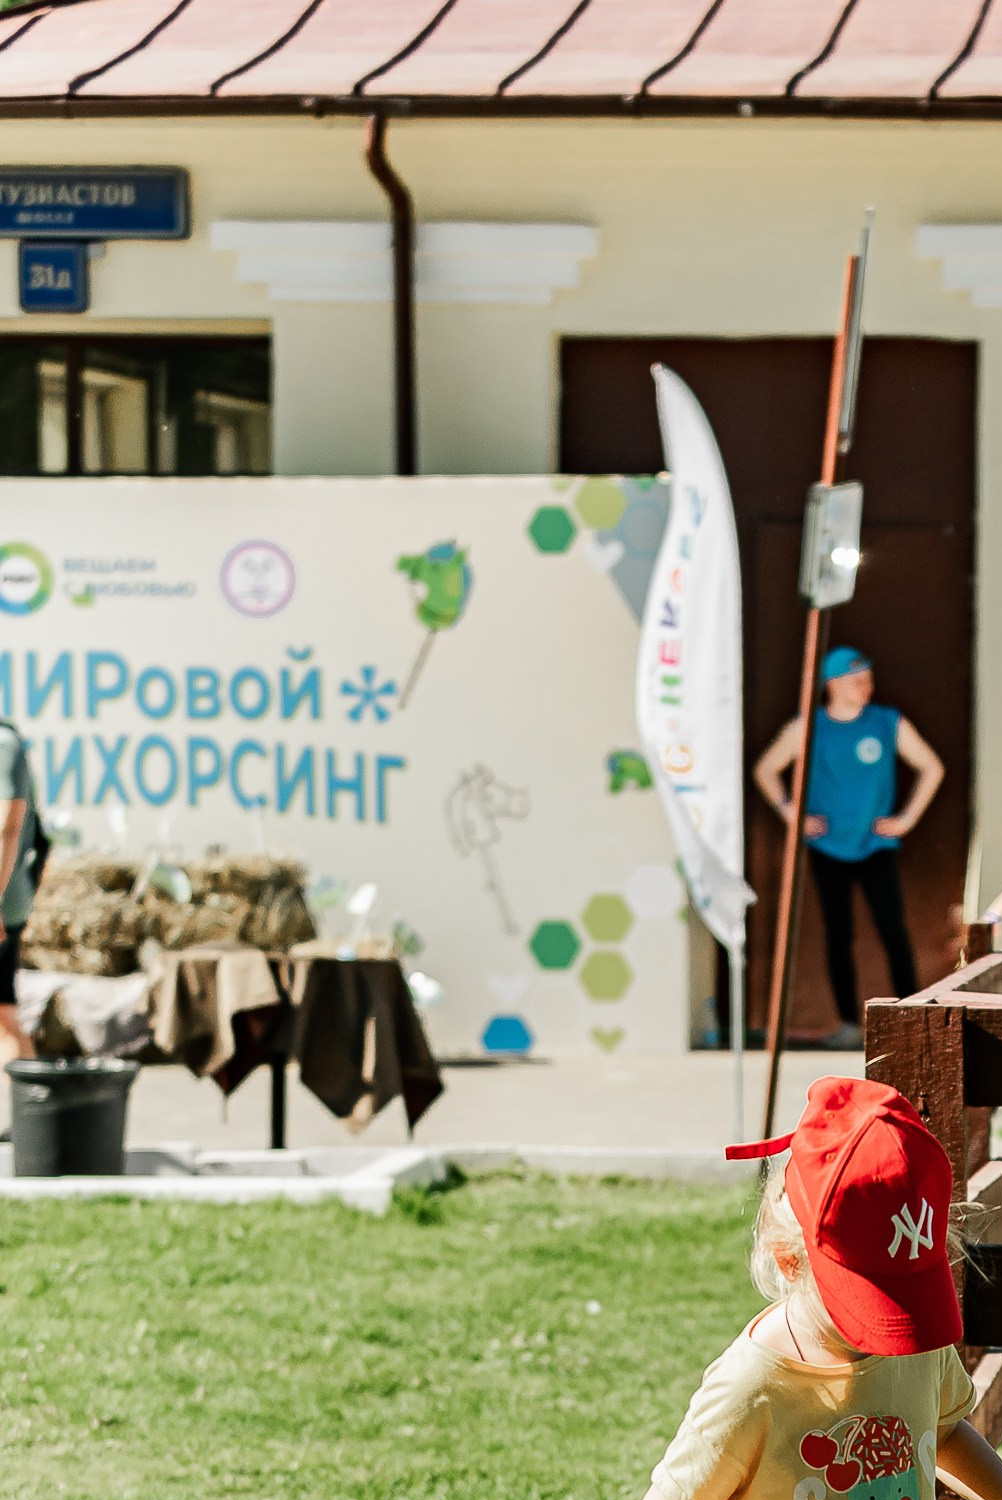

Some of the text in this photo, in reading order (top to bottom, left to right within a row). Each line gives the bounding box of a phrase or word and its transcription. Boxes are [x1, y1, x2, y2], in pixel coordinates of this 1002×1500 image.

[0, 645, 321, 721] ИРовой
[22, 732, 405, 825] ИХОРСИНГ
[888, 1197, 934, 1260] NY
